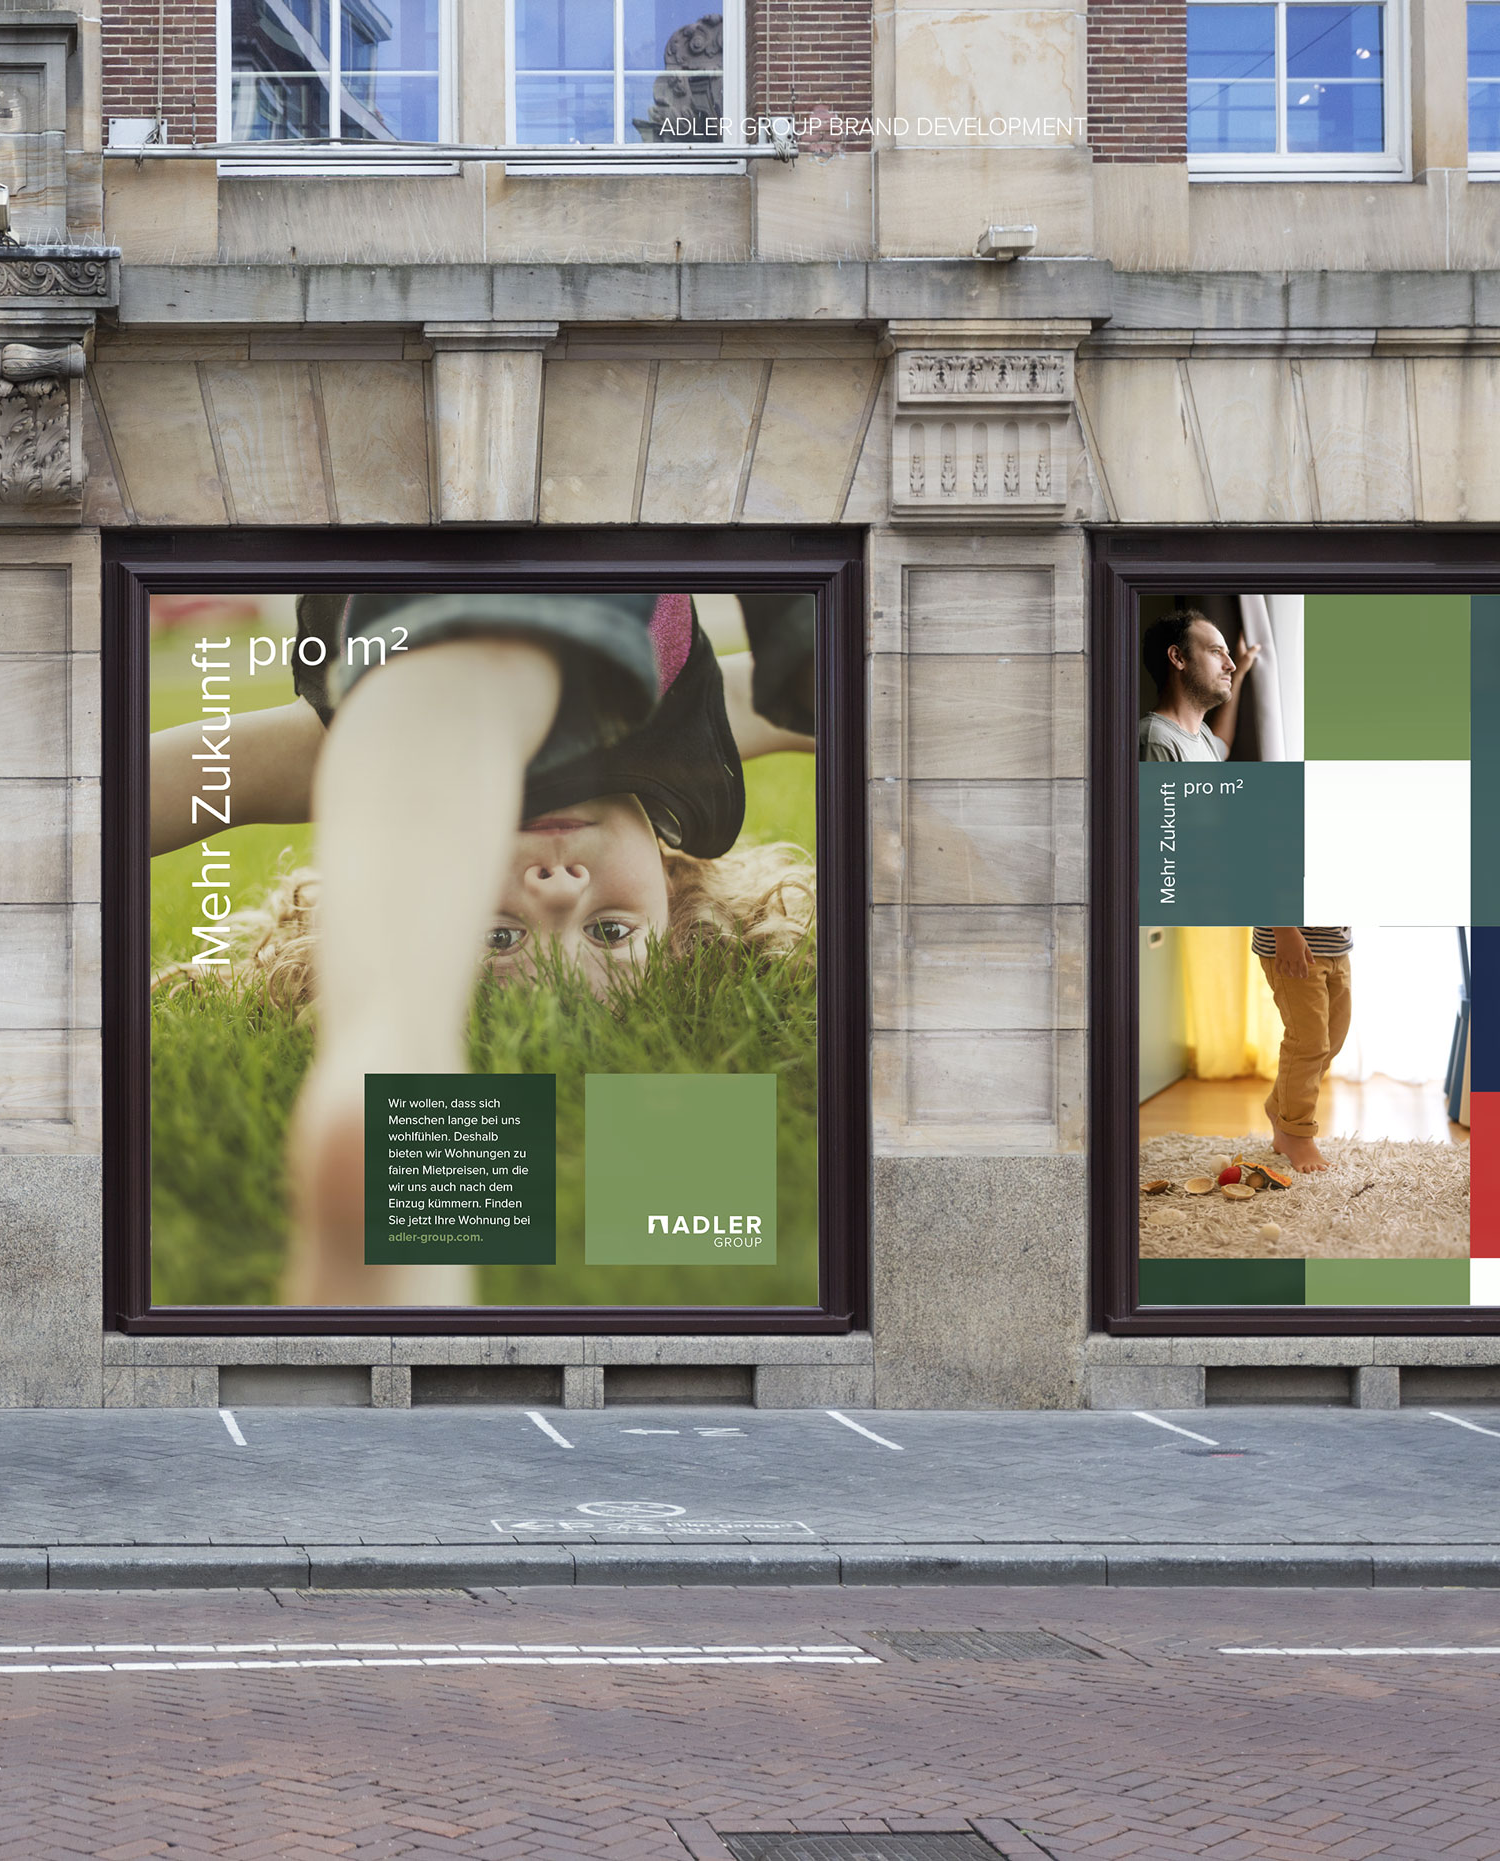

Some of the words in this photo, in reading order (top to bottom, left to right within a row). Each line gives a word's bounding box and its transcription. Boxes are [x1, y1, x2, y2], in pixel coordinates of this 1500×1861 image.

[249, 636, 326, 676] pro
[192, 636, 232, 824] Zukunft
[1184, 782, 1213, 798] pro
[1160, 782, 1176, 852] Zukunft
[1160, 858, 1176, 903] Mehr
[192, 842, 232, 964] Mehr
[388, 1099, 406, 1108] Wir
[409, 1099, 447, 1109] wollen,
[451, 1099, 476, 1108] dass
[479, 1099, 500, 1108] sich
[389, 1115, 444, 1125] Menschen
[448, 1115, 478, 1127] lange
[482, 1115, 497, 1125] bei
[502, 1117, 520, 1125] uns
[388, 1132, 450, 1141] wohlfühlen.
[454, 1132, 498, 1141] Deshalb
[389, 1149, 422, 1158] bieten
[426, 1149, 442, 1158] wir
[444, 1149, 510, 1160] Wohnungen
[389, 1165, 419, 1175] fairen
[423, 1165, 488, 1177] Mietpreisen,
[492, 1167, 508, 1175] um
[512, 1165, 528, 1175] die
[388, 1182, 404, 1191] wir
[430, 1182, 456, 1191] auch
[460, 1182, 485, 1191] nach
[489, 1182, 512, 1191] dem
[389, 1199, 424, 1210] Einzug
[428, 1199, 481, 1208] kümmern.
[485, 1199, 522, 1208] Finden
[389, 1215, 405, 1225] Sie
[407, 1216, 431, 1227] jetzt
[435, 1216, 455, 1225] Ihre
[458, 1215, 510, 1227] Wohnung
[514, 1216, 530, 1225] bei
[672, 1215, 762, 1234] ADLER
[389, 1232, 483, 1243] adler-group.com.
[713, 1237, 762, 1247] GROUP
